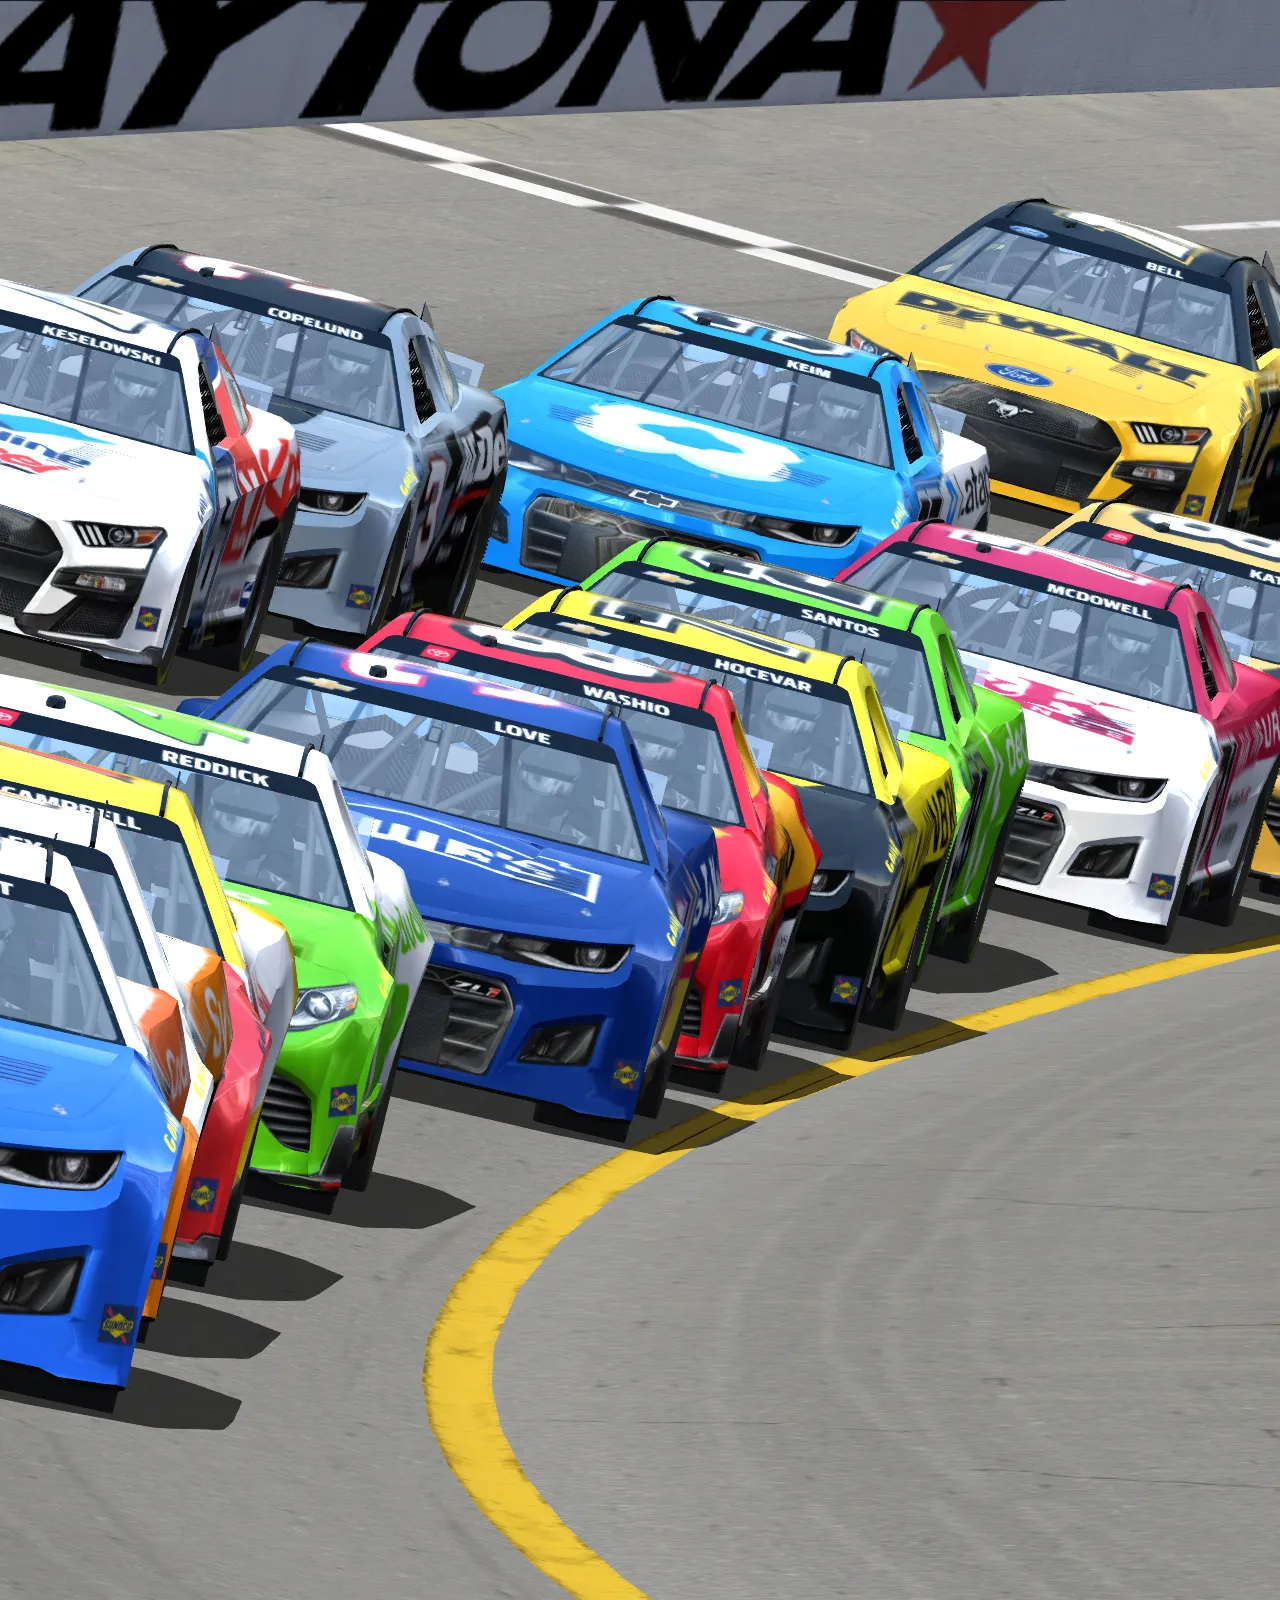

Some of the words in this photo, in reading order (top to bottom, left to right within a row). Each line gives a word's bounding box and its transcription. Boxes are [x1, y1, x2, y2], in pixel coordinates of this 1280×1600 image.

[1146, 261, 1184, 280] BELL
[268, 308, 364, 341] COPELUND
[41, 324, 161, 366] KESELOWSKI
[786, 359, 832, 379] KEIM
[1046, 583, 1153, 620] MCDOWELL
[801, 608, 880, 638] SANTOS
[715, 658, 813, 693] HOCEVAR
[582, 684, 670, 716] WASHIO
[494, 720, 551, 745] LOVE
[161, 750, 270, 788] REDDICK
[449, 980, 502, 998] ZL1
[102, 1315, 134, 1334] SUNOCO
